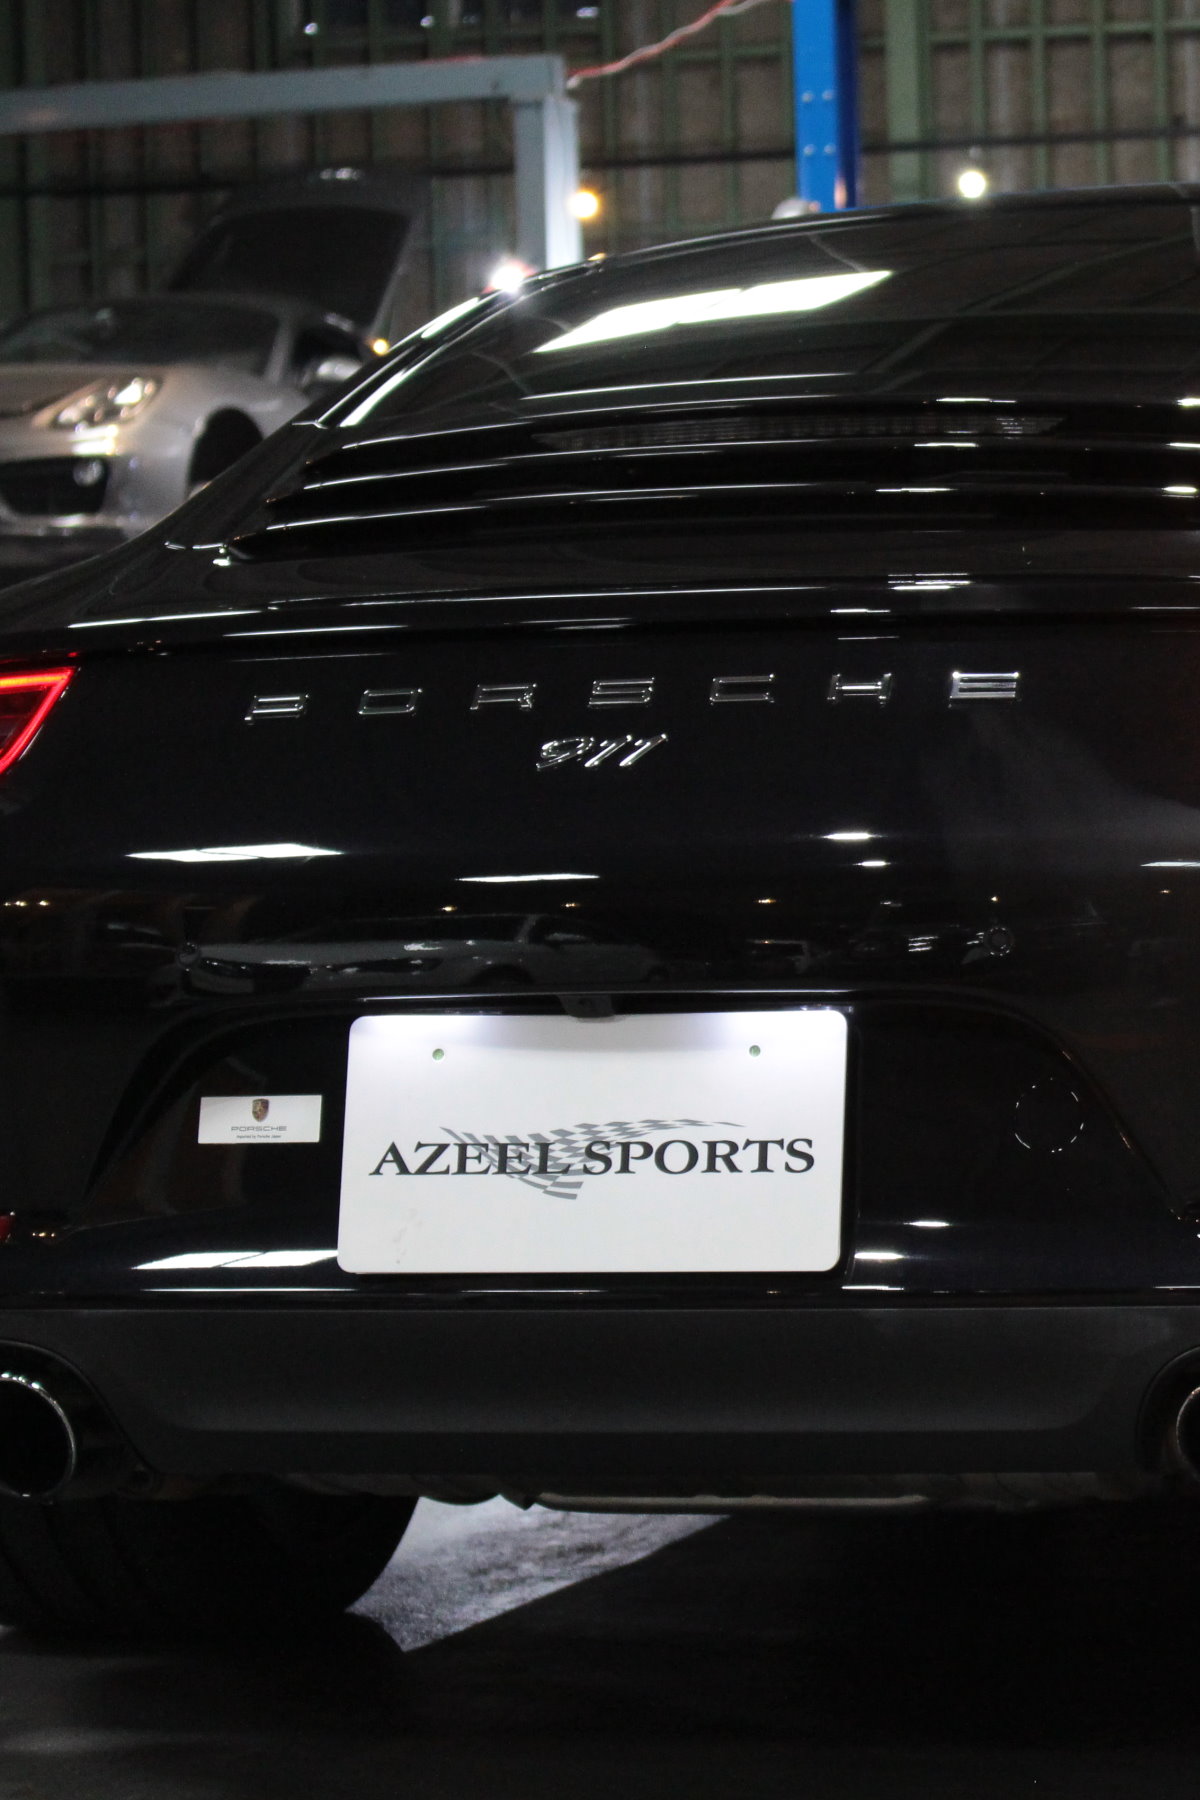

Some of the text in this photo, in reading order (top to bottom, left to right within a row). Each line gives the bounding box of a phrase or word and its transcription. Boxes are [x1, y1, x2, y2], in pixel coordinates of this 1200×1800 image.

[244, 671, 1021, 725] PORSCHE
[535, 732, 670, 770] 911
[368, 1138, 816, 1176] AZEEL SPORTS
